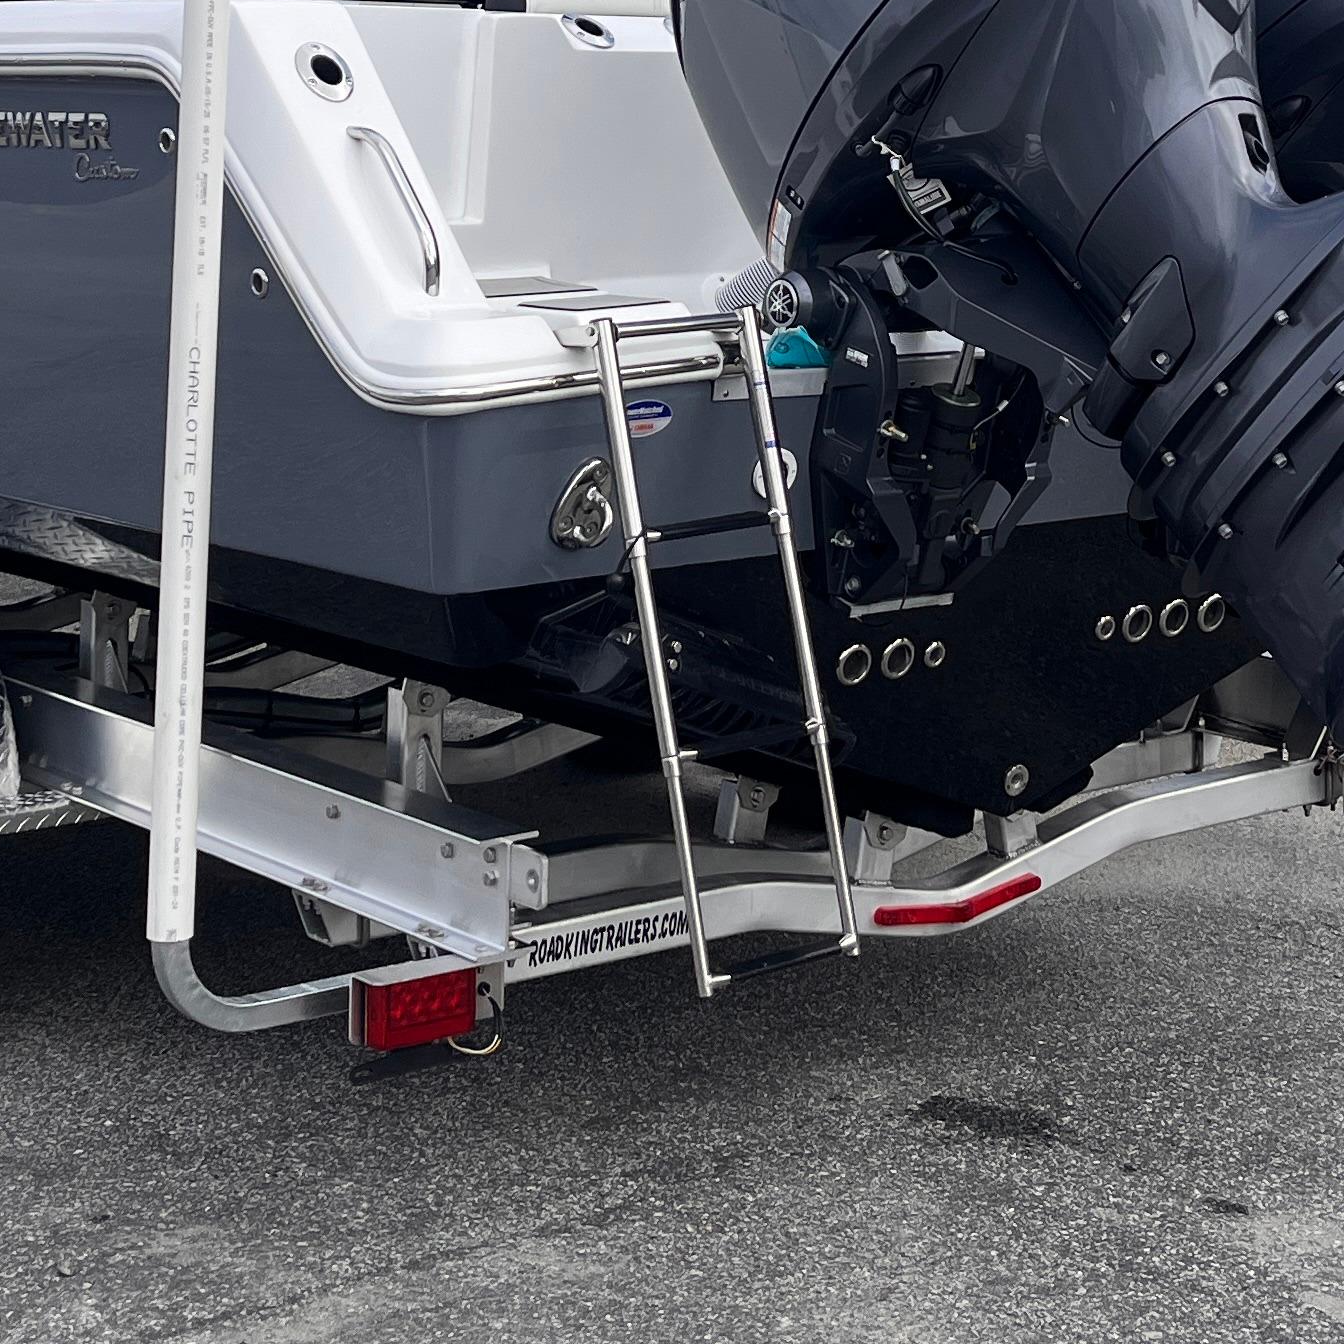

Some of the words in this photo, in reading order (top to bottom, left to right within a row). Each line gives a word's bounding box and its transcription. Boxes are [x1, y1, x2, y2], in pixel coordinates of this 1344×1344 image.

[183, 346, 201, 476] CHARLOTTE
[181, 490, 196, 549] PIPE
[528, 909, 689, 968] ROADKINGTRAILERS.COM
